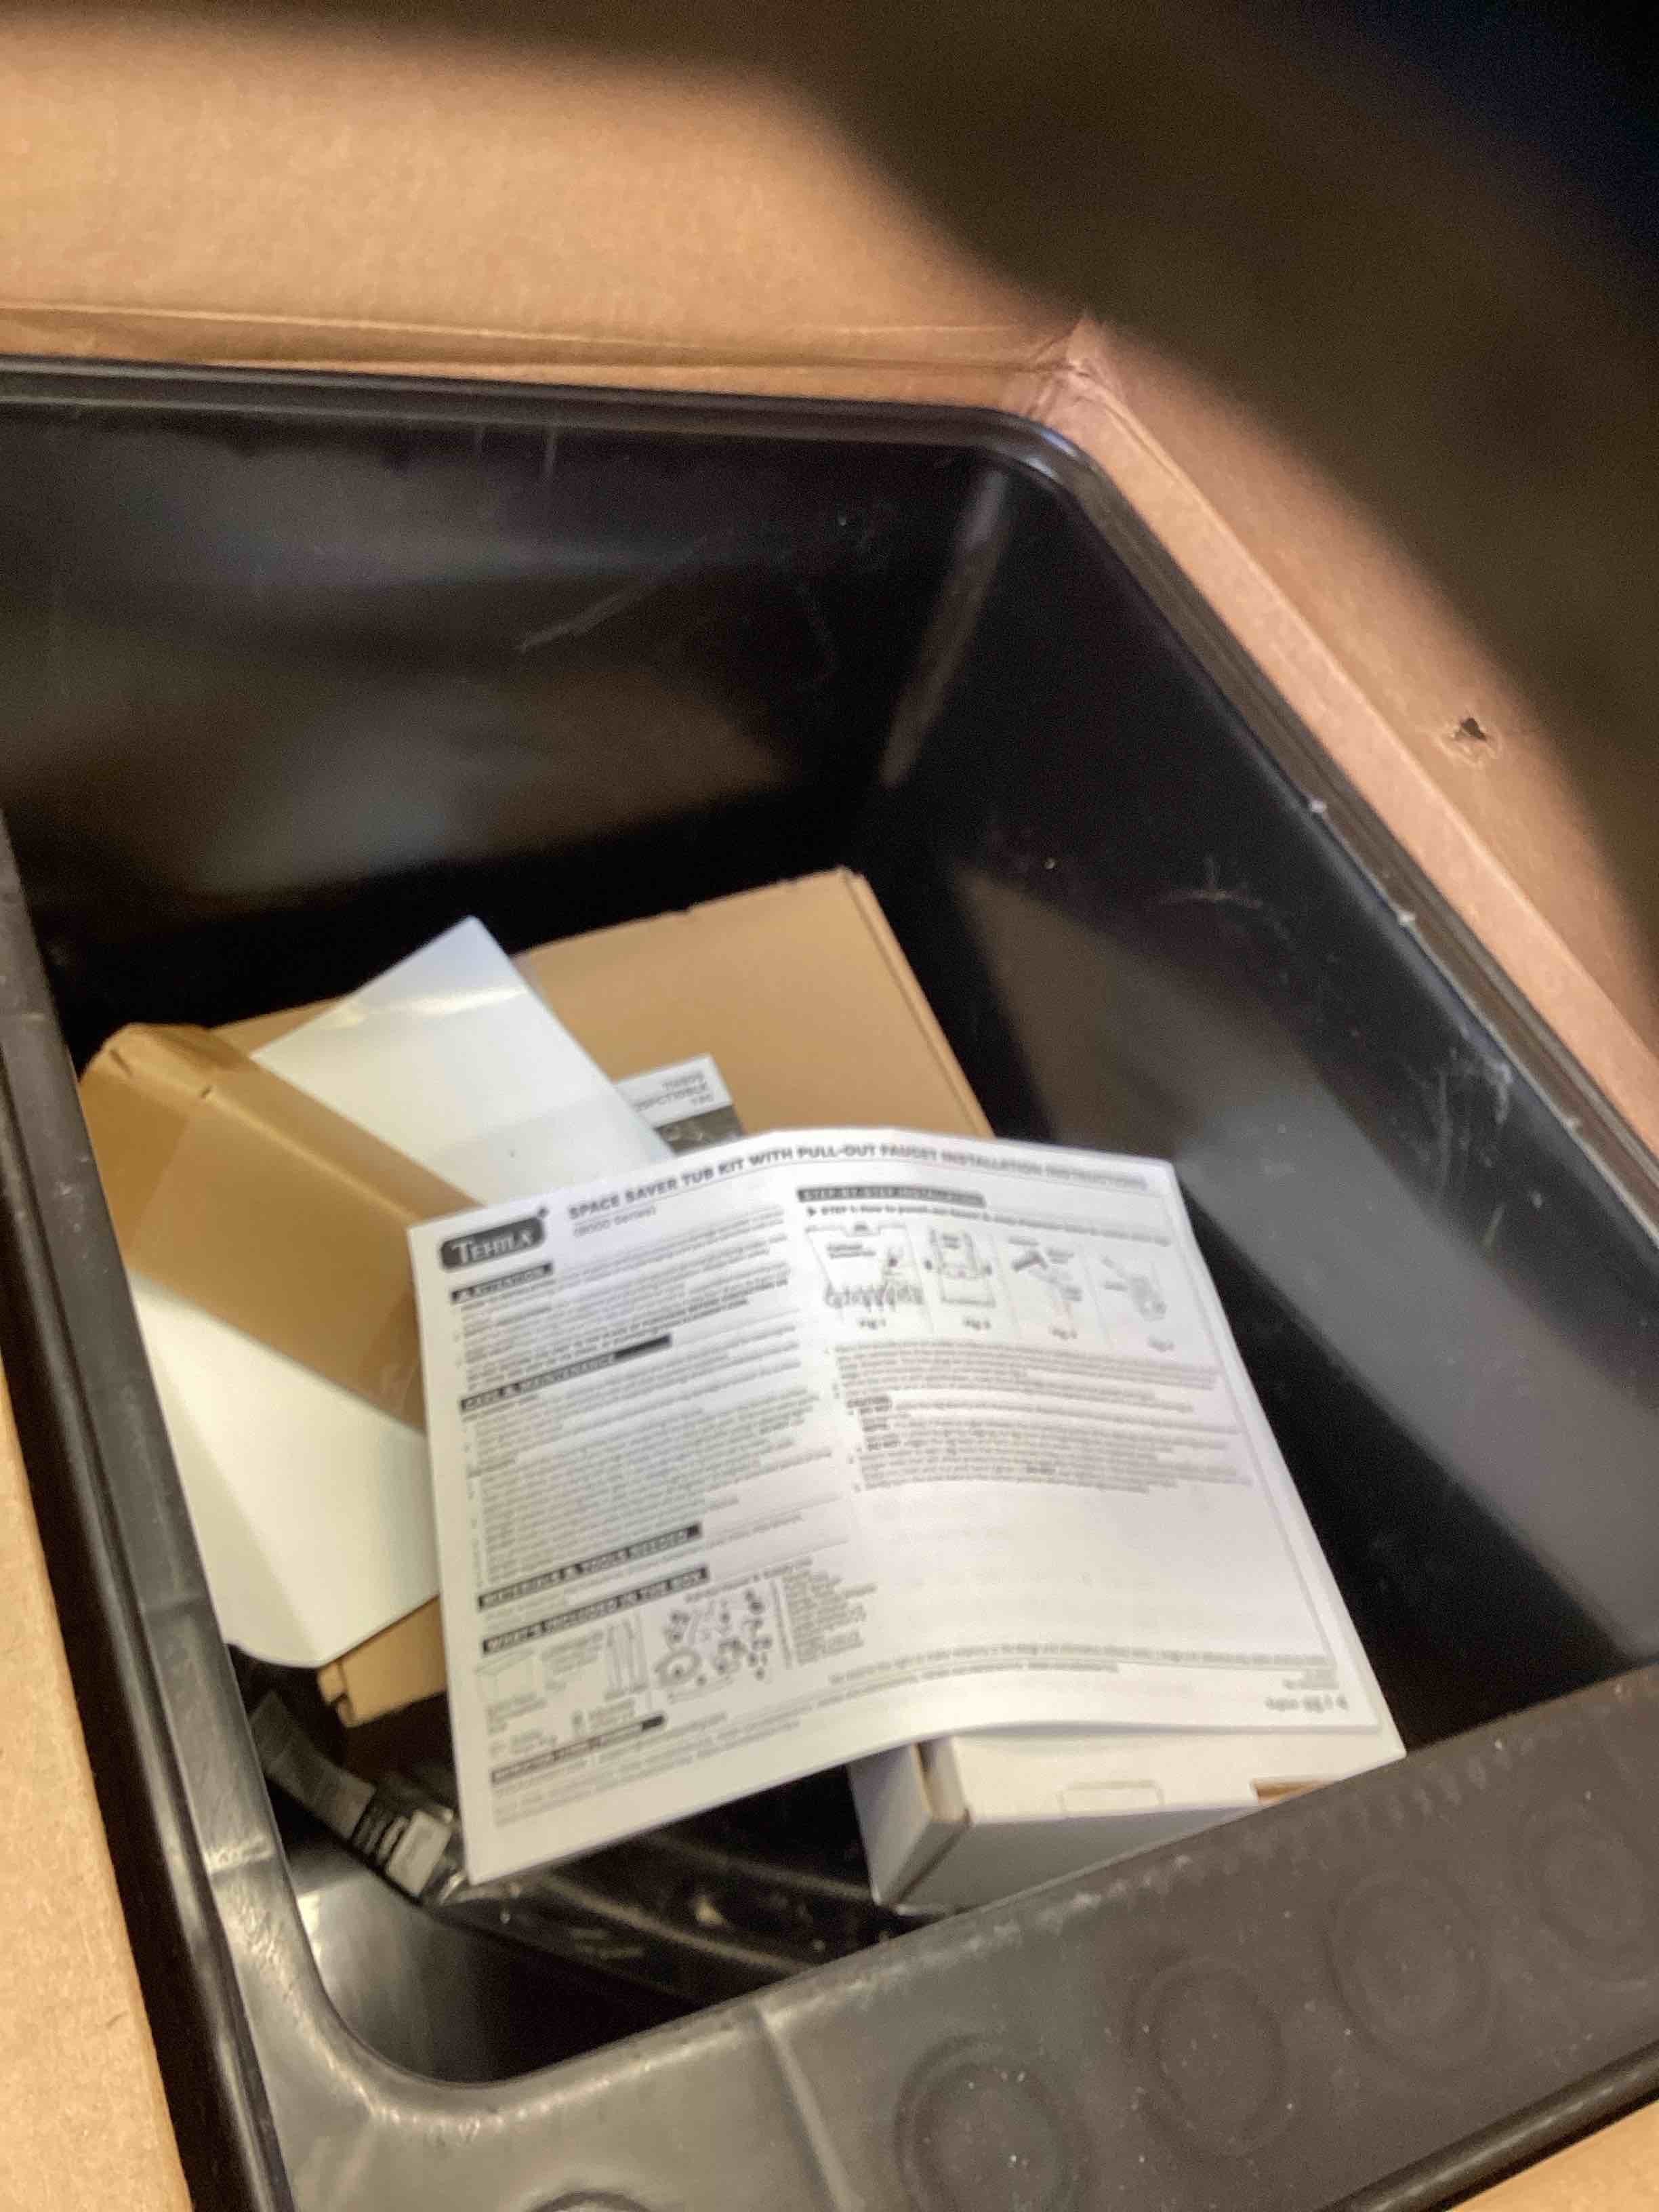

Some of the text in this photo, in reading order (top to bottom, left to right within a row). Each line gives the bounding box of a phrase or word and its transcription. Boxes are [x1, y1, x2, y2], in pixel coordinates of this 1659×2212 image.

[568, 1195, 619, 1219] SPACE
[625, 1178, 678, 1202] SAVER
[680, 1167, 714, 1186] TUB
[718, 1158, 744, 1176] KIT
[749, 1147, 792, 1166] WITH
[796, 1144, 876, 1158] PULL-OUT
